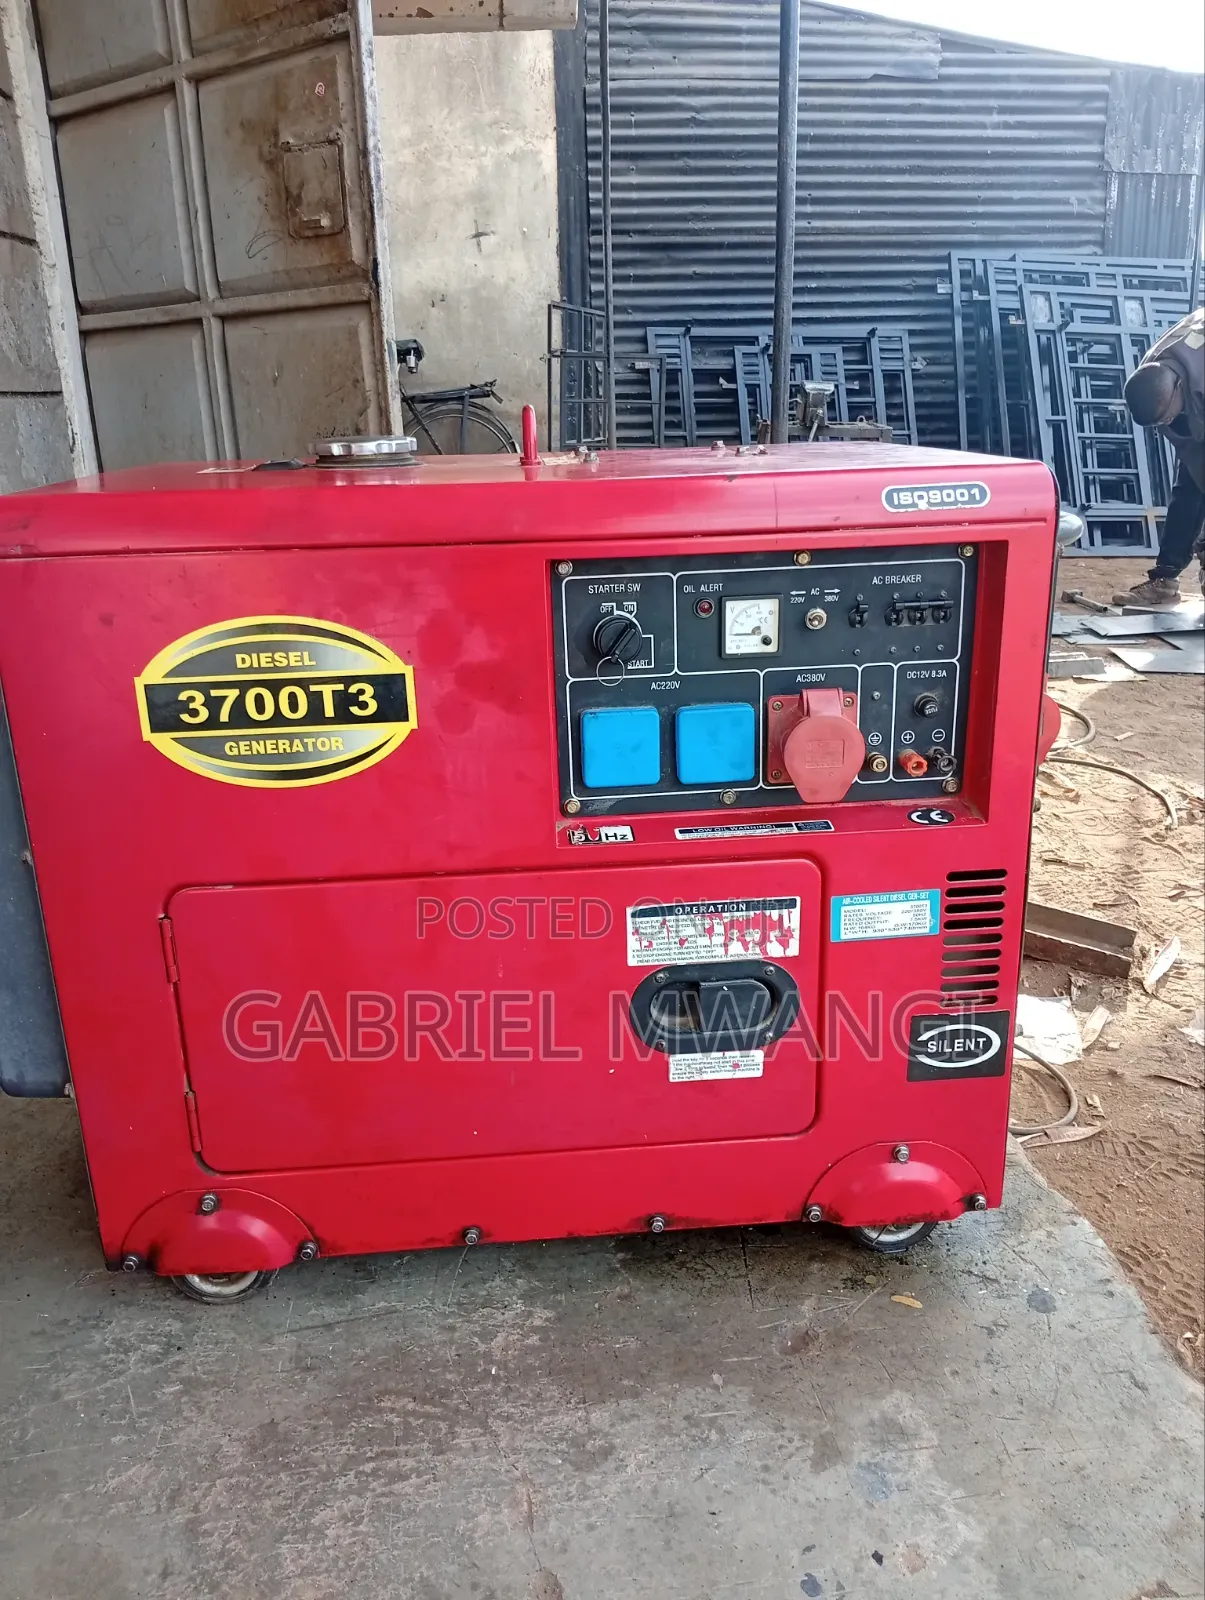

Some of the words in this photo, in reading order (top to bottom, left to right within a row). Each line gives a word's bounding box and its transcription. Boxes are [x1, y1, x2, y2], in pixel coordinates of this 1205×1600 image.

[872, 576, 883, 585] AC
[885, 574, 922, 584] BREAKER
[588, 584, 625, 594] STARTER
[628, 583, 641, 592] SW
[683, 585, 695, 593] OIL
[700, 583, 723, 592] ALERT
[235, 651, 316, 669] DIESEL
[796, 673, 826, 683] AC380V
[907, 671, 930, 679] DC12V
[931, 670, 947, 678] 8.3A
[651, 681, 681, 690] AC220V
[177, 683, 378, 724] 3700T3
[224, 737, 344, 756] GENERATOR
[842, 896, 872, 905] AIR-COOLED
[872, 894, 889, 903] SILENT
[889, 893, 907, 901] DIESEL
[907, 891, 929, 900] GEN-SET
[675, 904, 746, 915] OPERATION
[927, 1038, 986, 1053] SILENT
